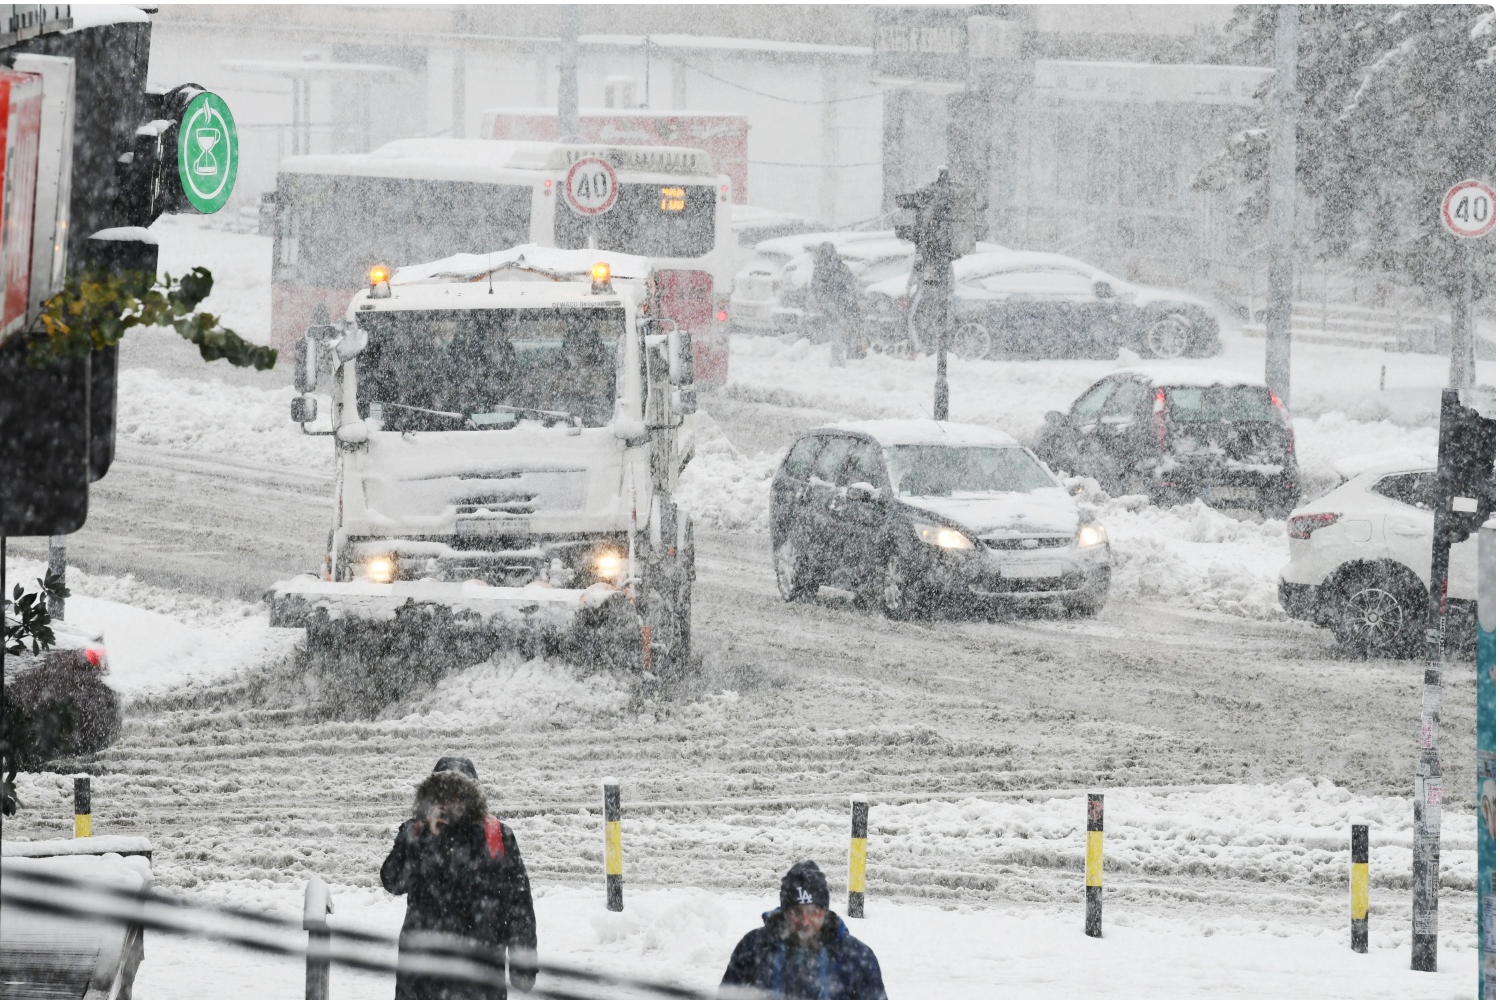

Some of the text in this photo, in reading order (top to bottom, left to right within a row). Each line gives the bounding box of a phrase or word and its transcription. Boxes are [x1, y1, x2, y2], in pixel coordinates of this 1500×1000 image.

[576, 172, 608, 200] 40
[1454, 196, 1487, 222] 40
[796, 886, 813, 904] LA
